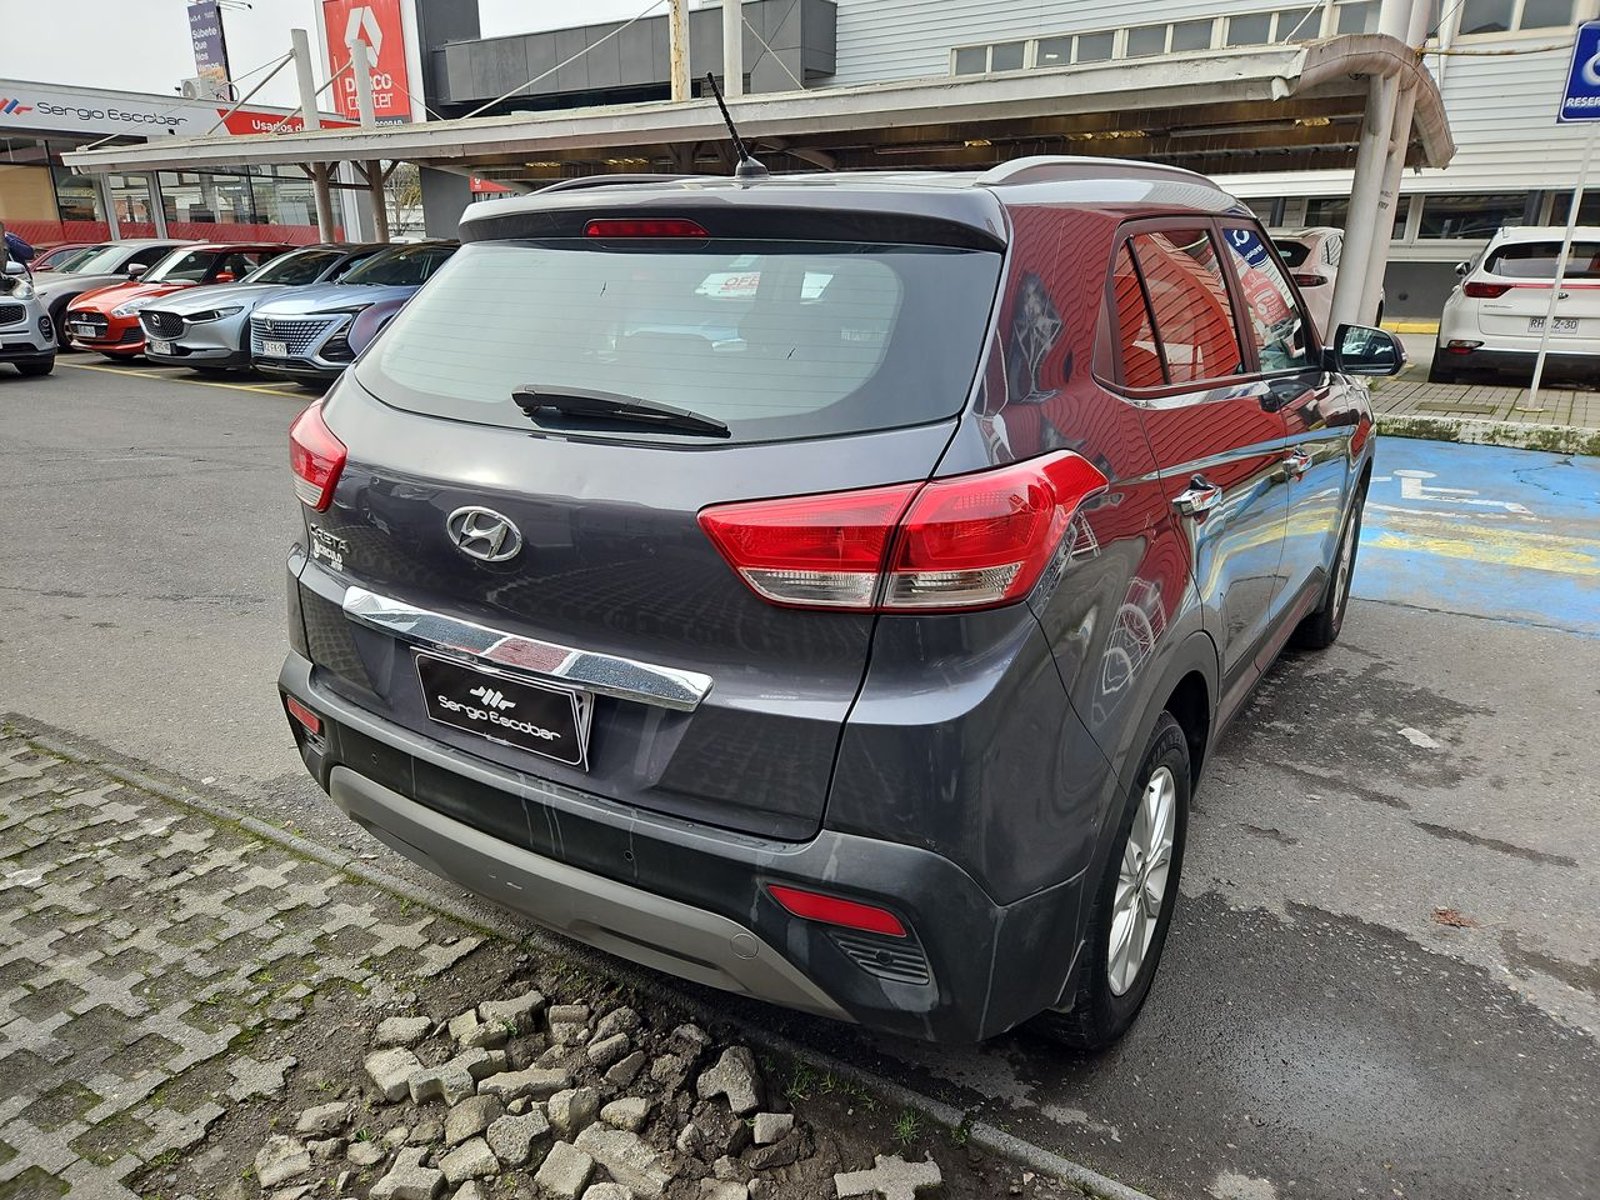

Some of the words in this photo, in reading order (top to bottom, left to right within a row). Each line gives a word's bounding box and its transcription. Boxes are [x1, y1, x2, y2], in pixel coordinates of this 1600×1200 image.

[37, 101, 105, 121] Sergio
[107, 108, 189, 126] Escobar
[347, 91, 393, 110] cter
[310, 522, 351, 554] CRETA
[489, 710, 561, 741] Escobar
